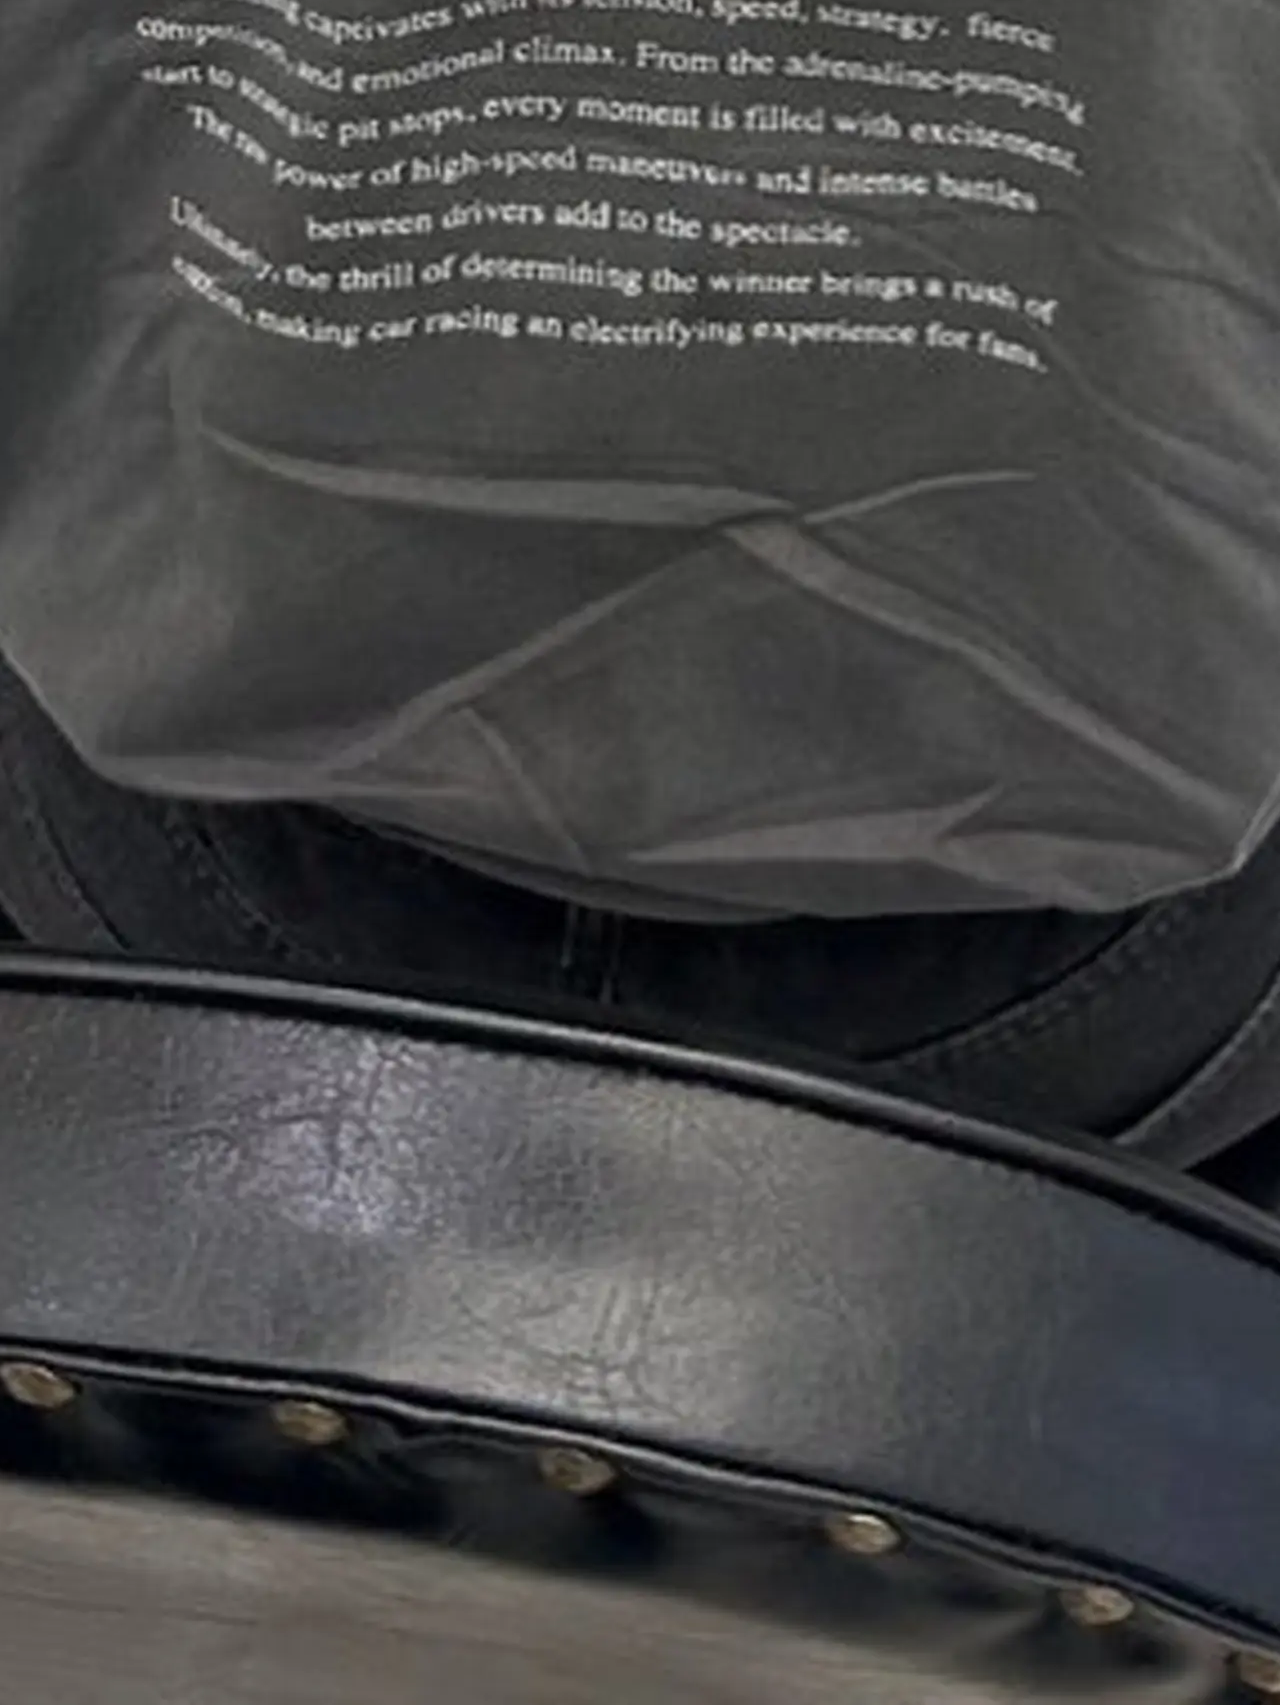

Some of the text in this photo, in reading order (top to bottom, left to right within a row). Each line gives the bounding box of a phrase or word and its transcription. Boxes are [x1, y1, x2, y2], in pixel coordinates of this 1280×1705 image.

[303, 5, 454, 45] captivates
[967, 10, 1056, 53] fierce
[296, 58, 344, 92] and
[351, 38, 505, 95] emotional
[635, 40, 720, 74] From
[726, 46, 775, 76] the
[208, 63, 236, 90] to
[337, 118, 379, 147] pit
[482, 94, 567, 123] every
[576, 96, 702, 130] moment
[708, 103, 736, 131] is
[743, 103, 825, 133] filled
[831, 108, 902, 140] with
[186, 102, 234, 144] The
[274, 157, 363, 191] power
[370, 157, 407, 186] of
[410, 142, 577, 185] high-speed
[586, 151, 747, 187] maneuvers
[757, 164, 811, 194] and
[819, 164, 929, 196] intense
[305, 213, 433, 241] between
[441, 199, 545, 230] drivers
[554, 199, 611, 230] add
[616, 208, 648, 233] to
[653, 208, 702, 240] the
[284, 263, 332, 293] the
[338, 260, 415, 293] thrill
[421, 251, 458, 284] of
[460, 250, 643, 297] determining
[650, 265, 699, 293] the
[708, 272, 813, 294] winner
[820, 271, 918, 302] brings
[923, 278, 944, 299] a
[951, 279, 1020, 311] rush
[1024, 297, 1059, 326] of
[254, 307, 361, 349] making
[367, 316, 418, 342] car
[424, 304, 519, 338] racing
[525, 316, 563, 340] an
[570, 313, 745, 350] electrifying
[752, 318, 919, 347] experience
[924, 320, 972, 351] for
